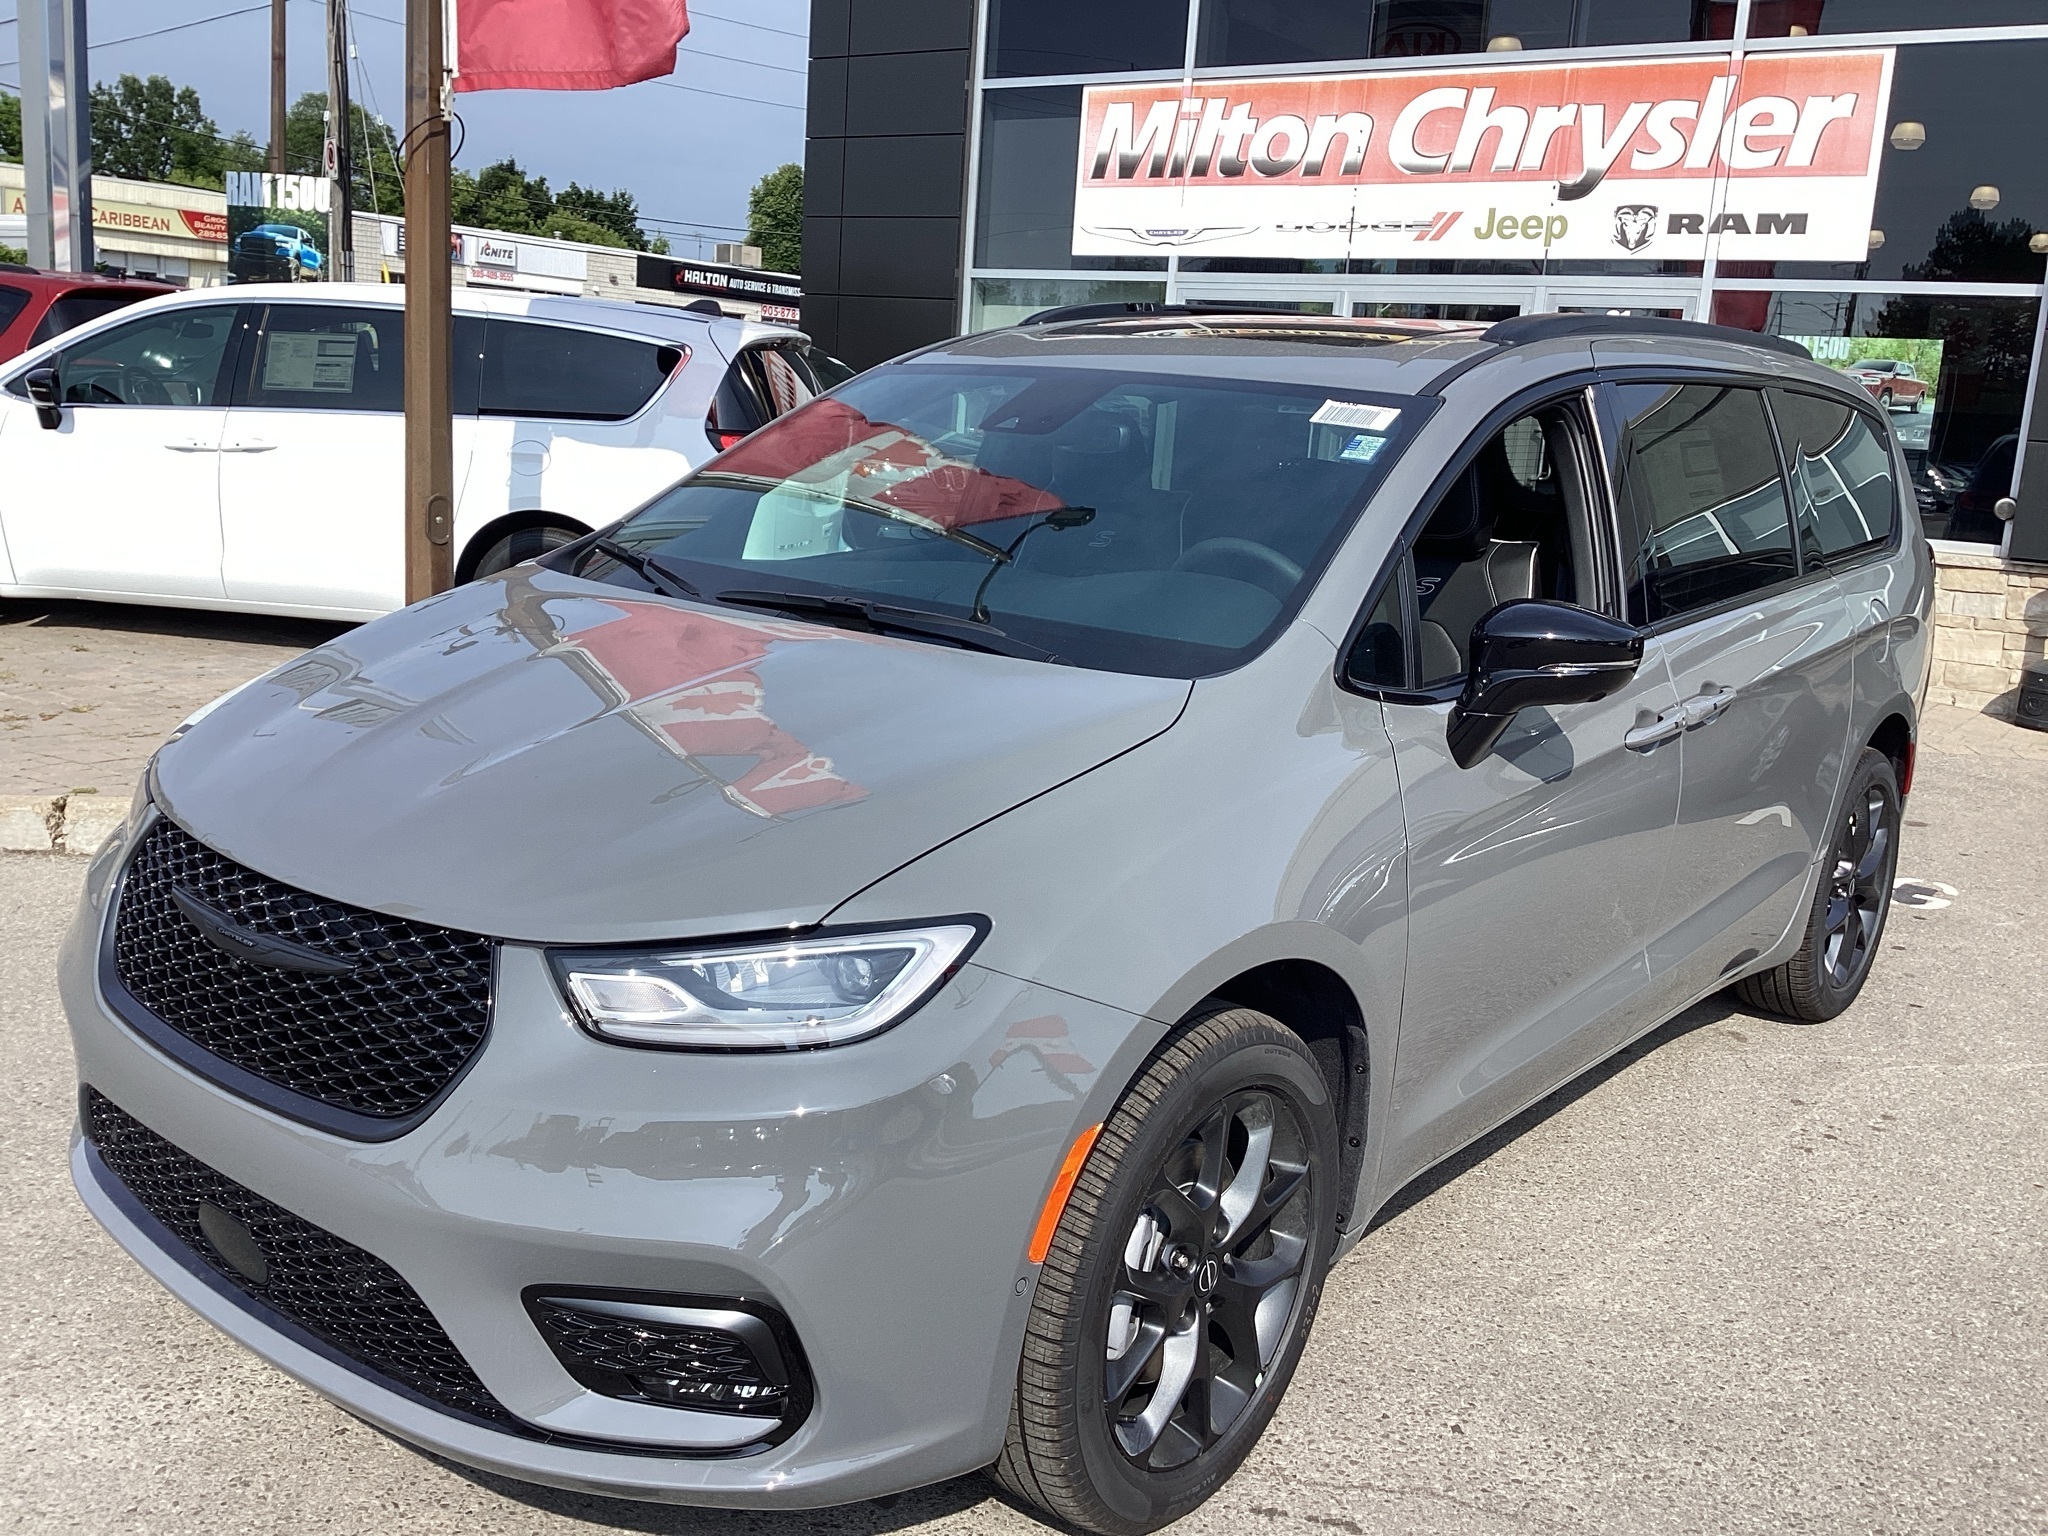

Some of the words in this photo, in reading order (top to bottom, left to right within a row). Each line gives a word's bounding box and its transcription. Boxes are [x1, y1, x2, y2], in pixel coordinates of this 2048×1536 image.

[1090, 97, 1374, 180] Milton
[1387, 75, 1859, 201] Chrysler
[226, 171, 271, 208] RAM
[276, 173, 331, 213] 1500
[194, 220, 226, 231] BEAUTY
[1276, 220, 1433, 233] DODGE
[1474, 207, 1568, 247] Jeep
[1667, 213, 1809, 235] RAM
[480, 244, 514, 260] IGNITE
[684, 269, 728, 288] HALTON
[728, 278, 743, 290] AUTO
[744, 280, 766, 293] SERVICE
[1812, 335, 1851, 360] 1500
